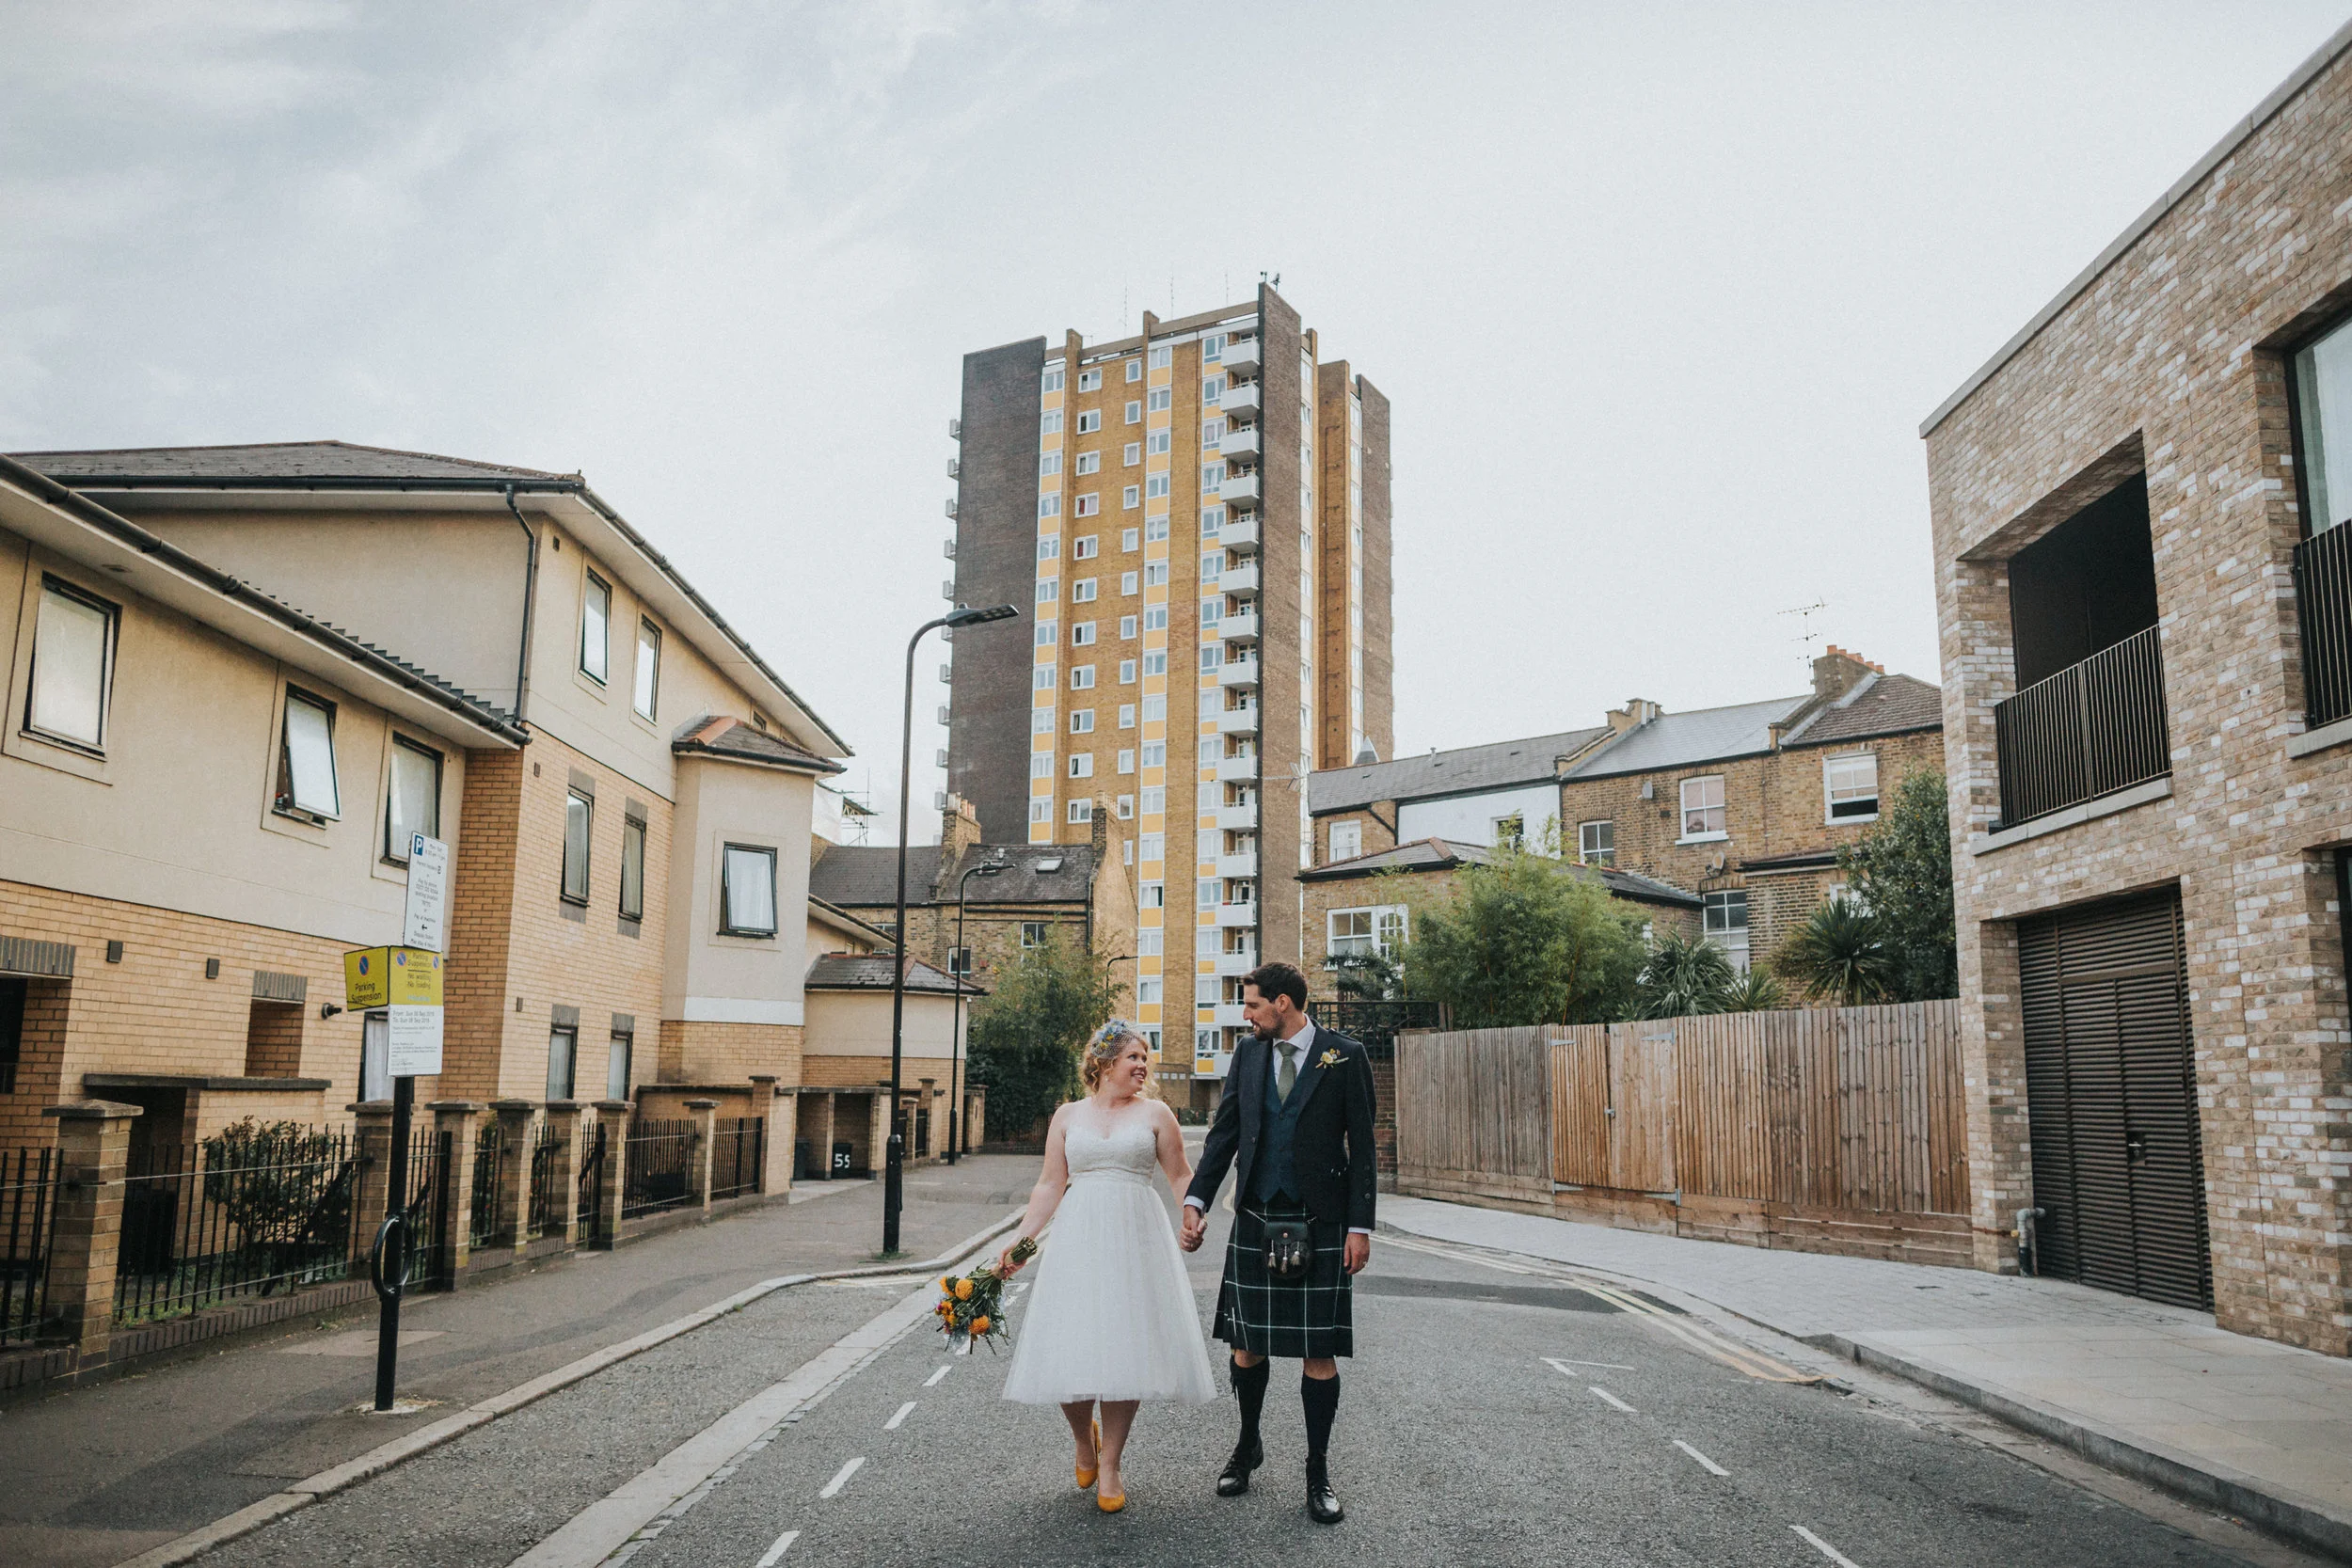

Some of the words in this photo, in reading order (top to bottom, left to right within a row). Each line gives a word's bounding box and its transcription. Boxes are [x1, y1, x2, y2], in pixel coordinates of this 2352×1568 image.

[416, 837, 422, 853] P
[412, 952, 429, 961] Parking
[407, 958, 432, 969] Suspension
[355, 982, 375, 992] Parking
[416, 981, 431, 990] loading
[351, 992, 382, 1004] Suspension
[834, 1153, 850, 1169] 55
